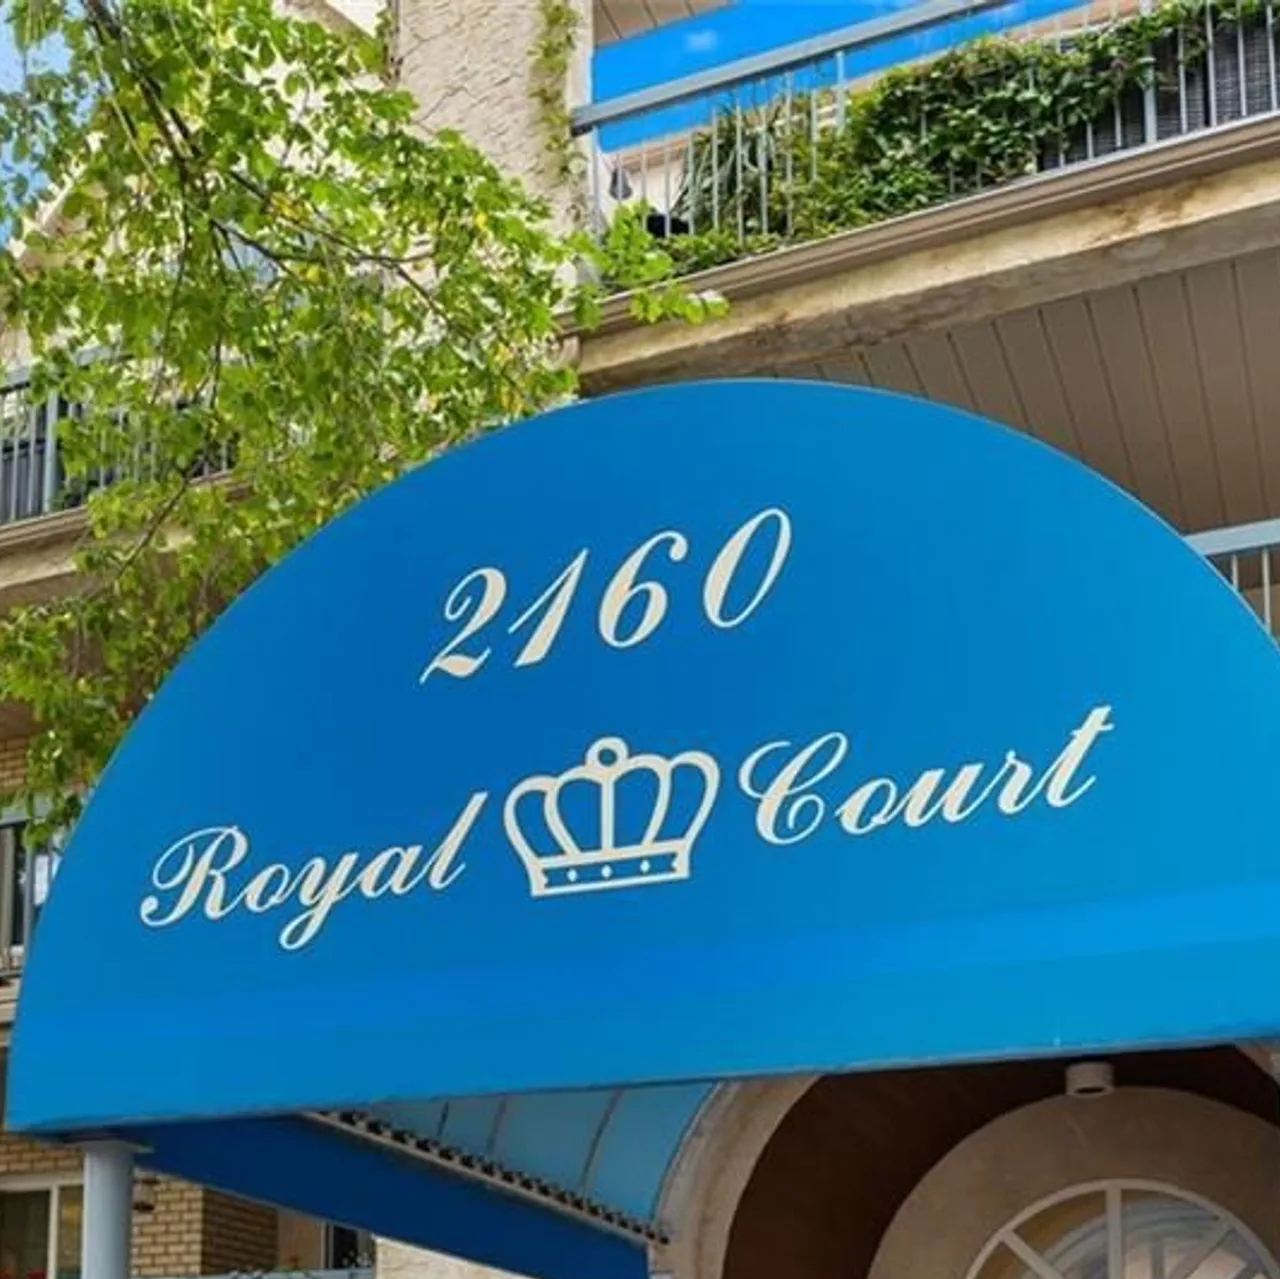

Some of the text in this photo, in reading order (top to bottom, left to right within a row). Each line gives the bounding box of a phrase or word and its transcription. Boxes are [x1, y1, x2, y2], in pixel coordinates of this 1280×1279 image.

[420, 508, 791, 683] 2160
[140, 705, 1114, 950] Royal Court
